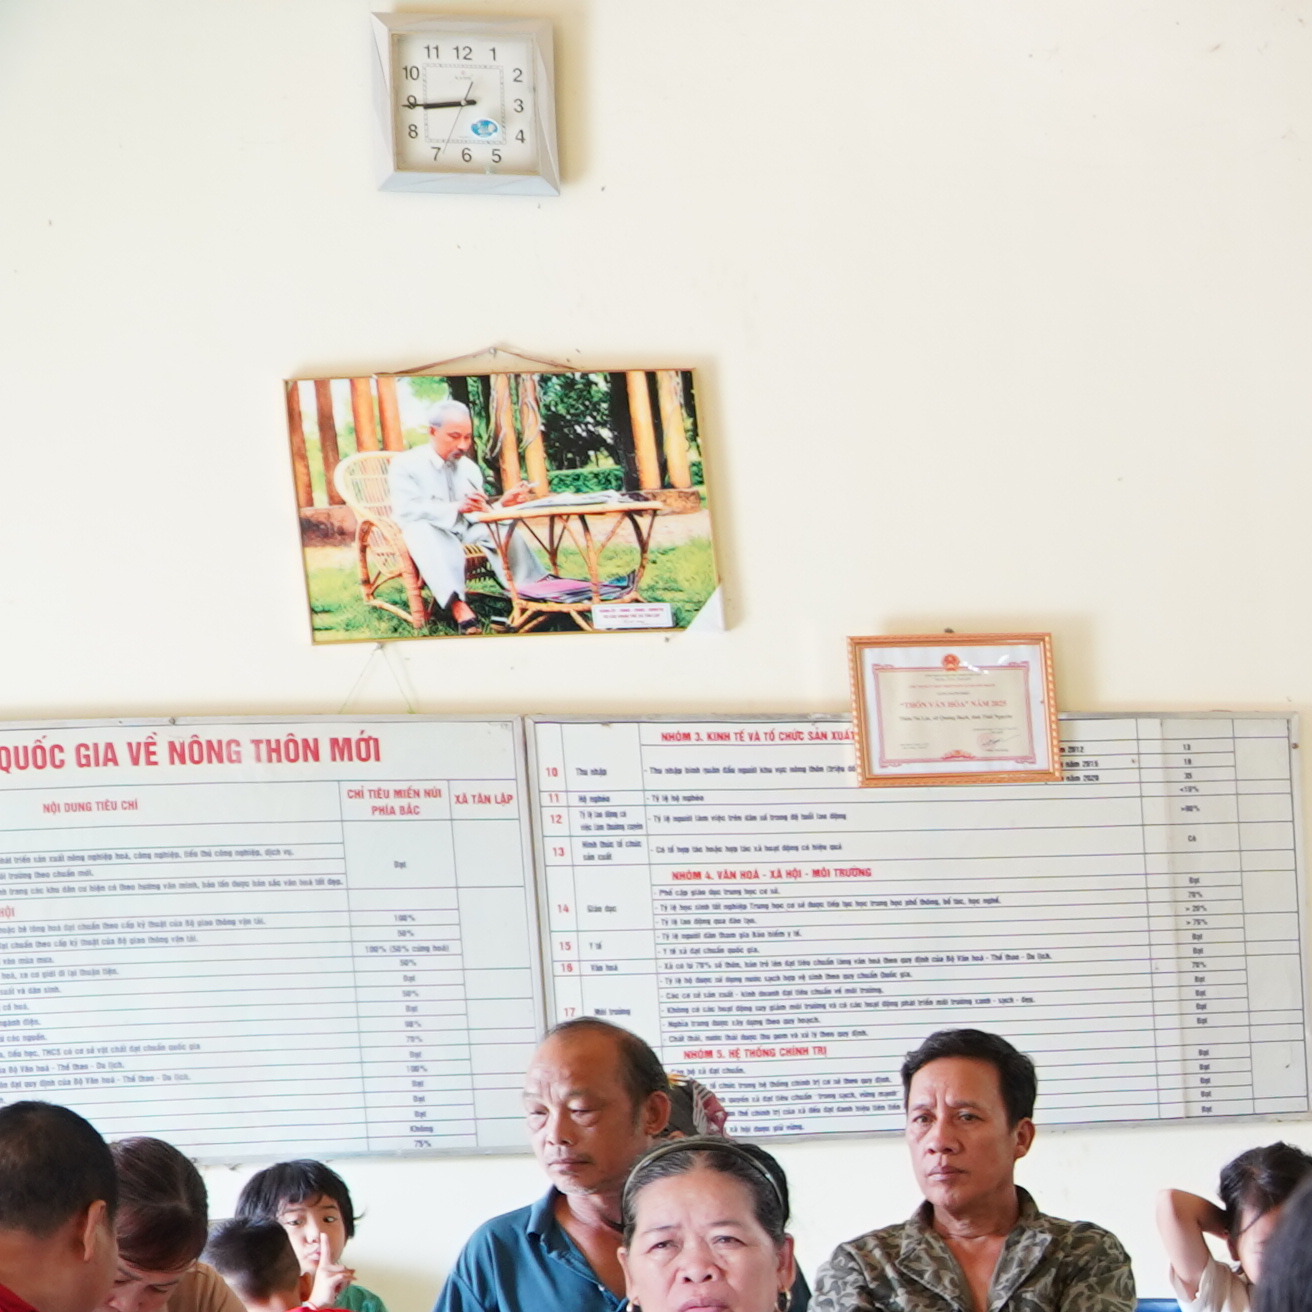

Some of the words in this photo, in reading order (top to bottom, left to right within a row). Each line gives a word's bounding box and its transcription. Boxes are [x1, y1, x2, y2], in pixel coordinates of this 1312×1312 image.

[424, 45, 440, 59] 11
[453, 46, 473, 60] 12
[489, 47, 497, 61] 1
[402, 66, 420, 80] 10
[512, 68, 523, 82] 2
[406, 95, 417, 110] 9
[513, 99, 524, 113] 3
[408, 124, 418, 139] 8
[515, 129, 526, 143] 4
[430, 147, 442, 161] 7
[461, 148, 472, 163] 6
[491, 149, 502, 163] 5
[661, 730, 691, 742] NHÓM
[707, 731, 731, 741] KINH
[0, 735, 65, 774] QUỐC
[75, 742, 119, 769] GIA
[127, 732, 159, 767] VỀ
[168, 734, 242, 766] NÔNG
[250, 734, 320, 764] THÔN
[330, 731, 381, 763] MỚI
[546, 766, 558, 777] 10
[549, 793, 560, 802] 11
[64, 801, 92, 813] DUNG
[95, 799, 117, 812] TIÊU
[550, 814, 562, 824] 12
[552, 847, 565, 857] 13
[672, 870, 702, 881] NHÓM
[559, 941, 571, 951] 15
[564, 1007, 576, 1017] 17
[684, 1048, 714, 1060] NHÓM
